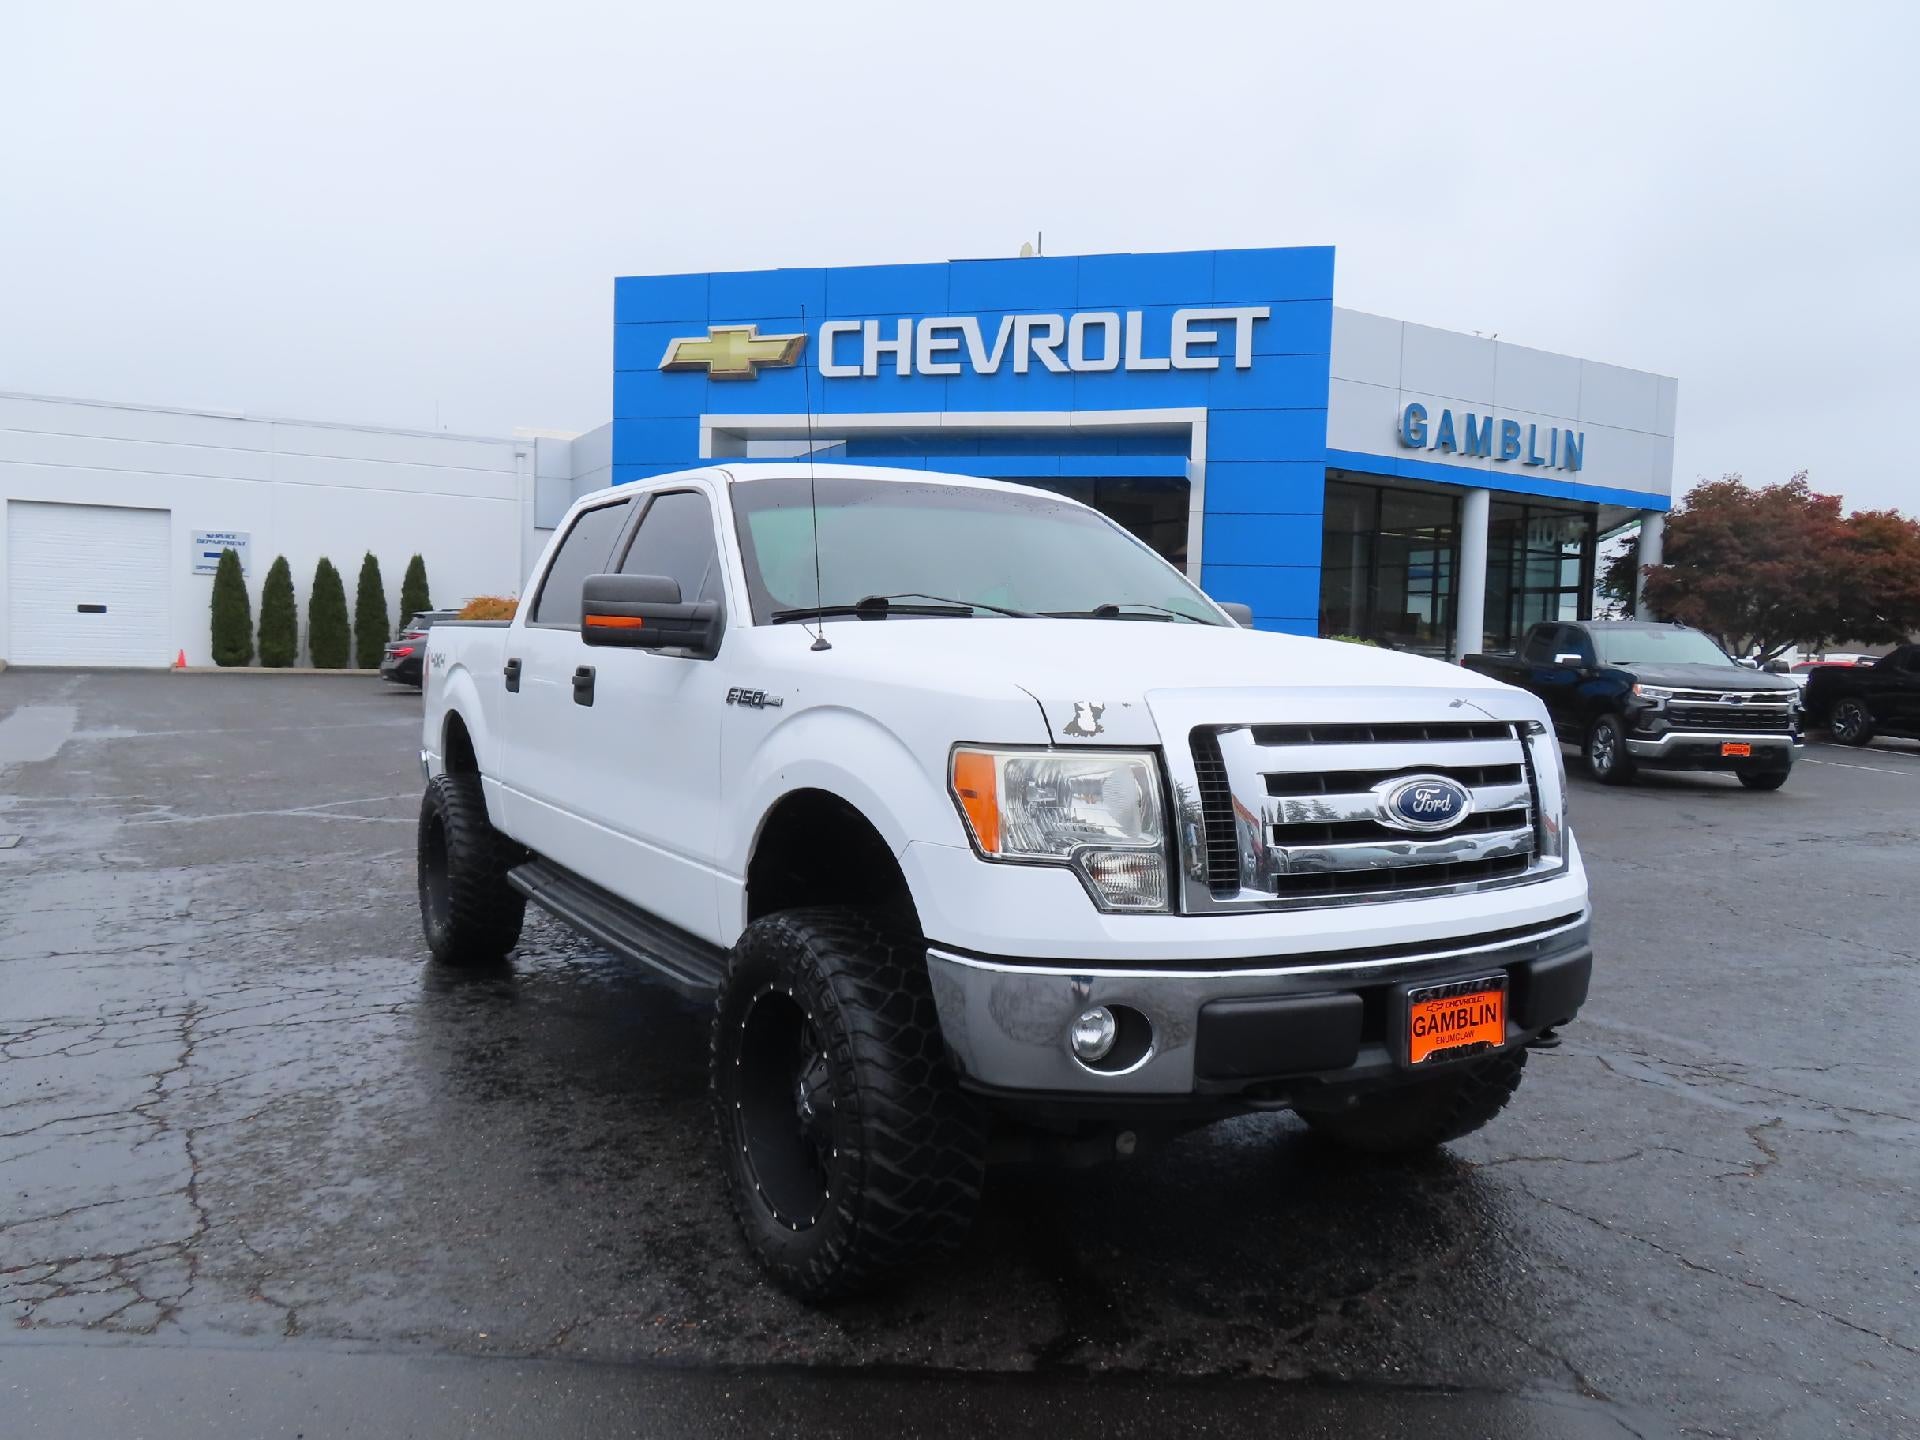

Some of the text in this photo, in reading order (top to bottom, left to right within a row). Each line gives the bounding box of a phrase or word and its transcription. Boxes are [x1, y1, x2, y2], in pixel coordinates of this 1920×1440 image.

[818, 306, 1270, 377] CHEVROLET
[1402, 403, 1584, 471] GAMBLIN
[196, 538, 246, 546] DEPARTMENT
[1412, 788, 1452, 813] Ford
[1445, 995, 1485, 1009] CHEVROLET
[1412, 1003, 1497, 1037] GAMBLIN
